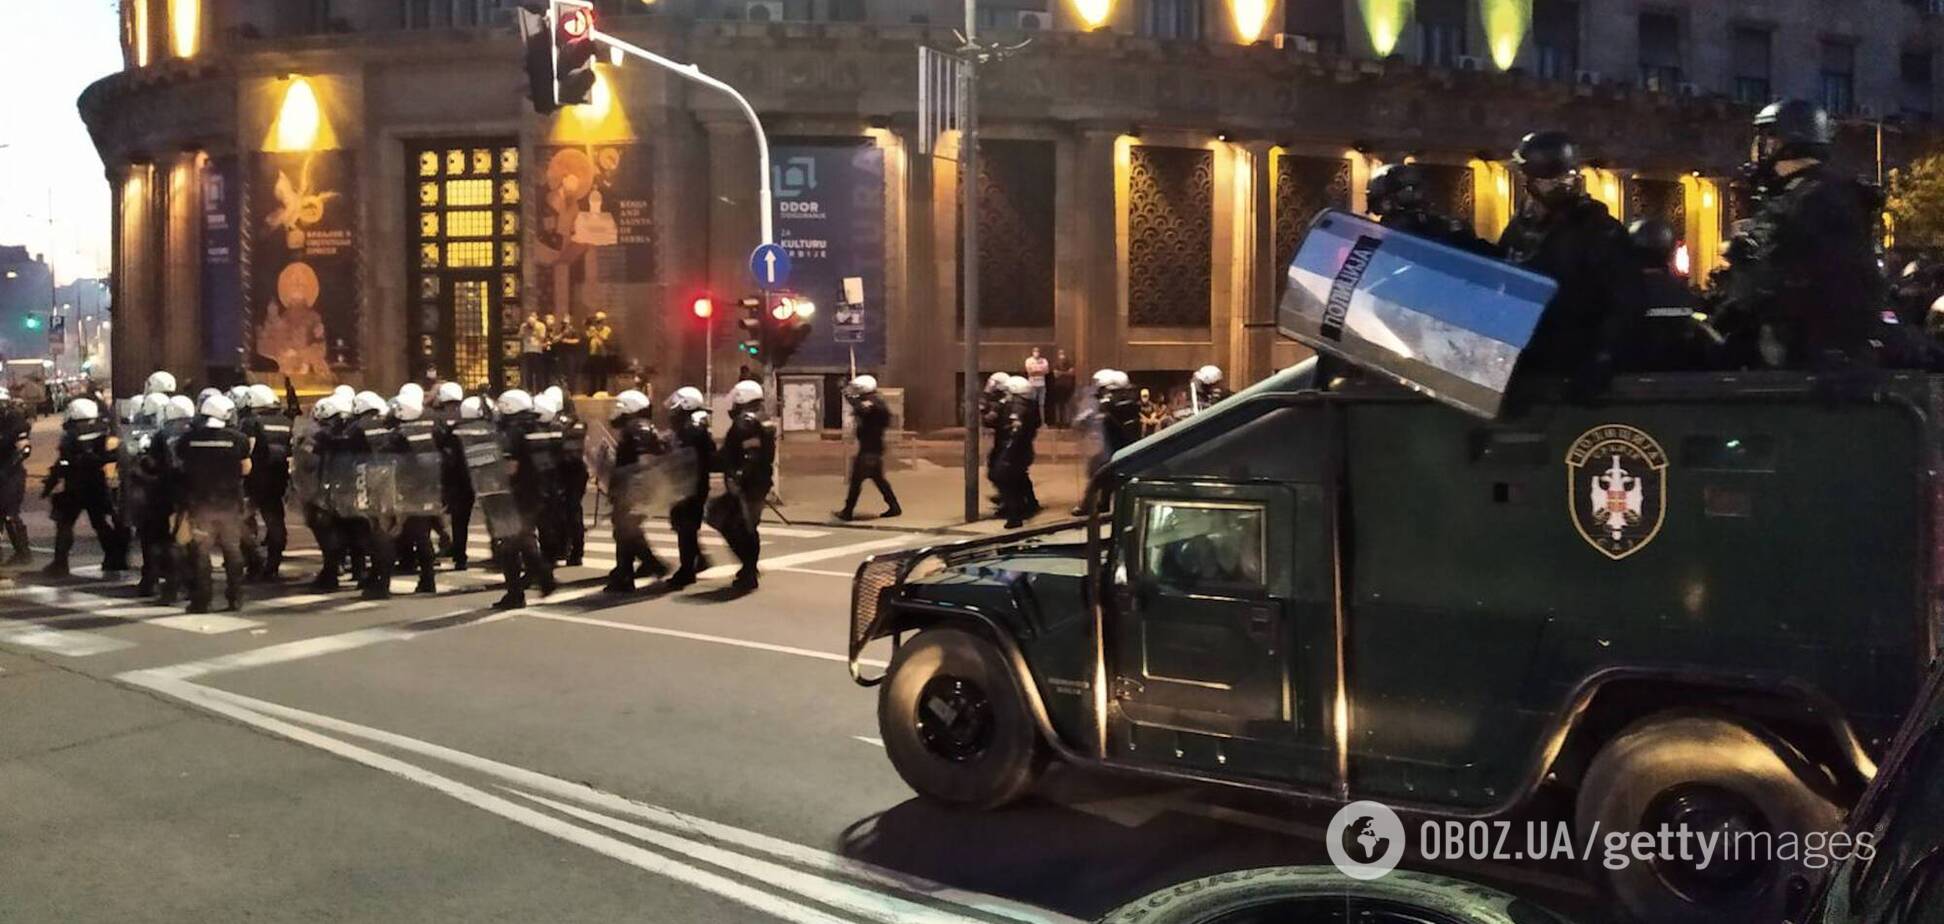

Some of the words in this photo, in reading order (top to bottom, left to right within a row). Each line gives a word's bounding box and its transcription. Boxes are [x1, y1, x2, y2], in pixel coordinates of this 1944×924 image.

[780, 201, 819, 212] DDOR
[781, 240, 827, 249] KULTURU
[1325, 248, 1373, 328] ПОЛИЦИЈА
